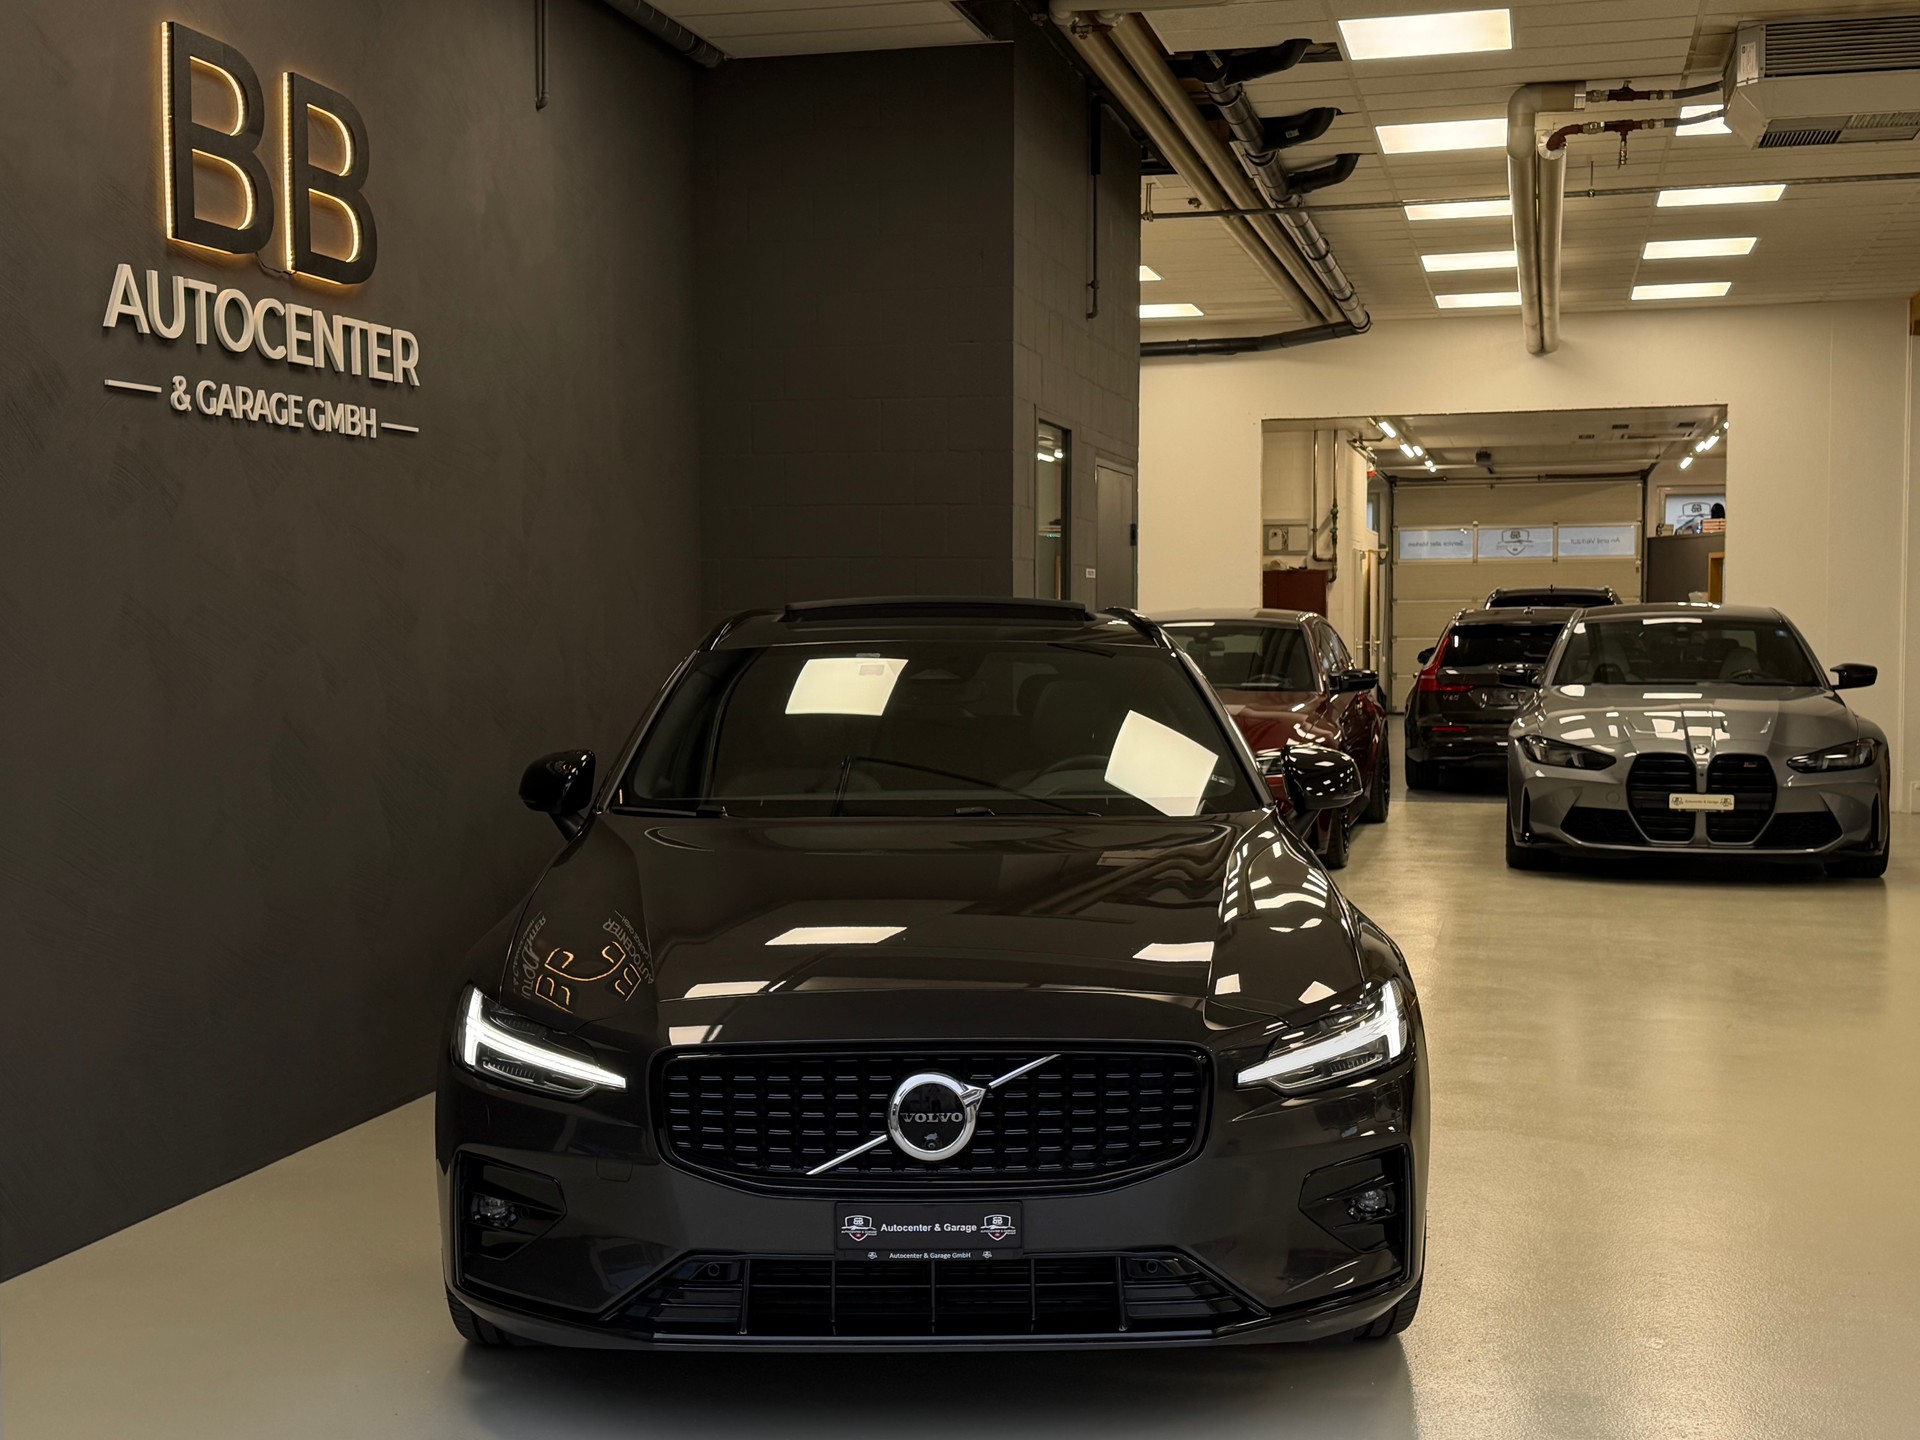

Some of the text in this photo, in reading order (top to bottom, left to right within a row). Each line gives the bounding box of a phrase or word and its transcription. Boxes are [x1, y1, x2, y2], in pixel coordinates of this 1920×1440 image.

[161, 21, 377, 285] BB
[103, 264, 420, 386] AUTOCENTER
[170, 375, 377, 438] & GARAGE GMBH
[900, 1112, 963, 1122] VOLVO
[880, 1224, 932, 1232] Autocenter
[934, 1223, 941, 1232] &
[943, 1223, 977, 1233] Garage
[930, 1252, 951, 1260] Garage
